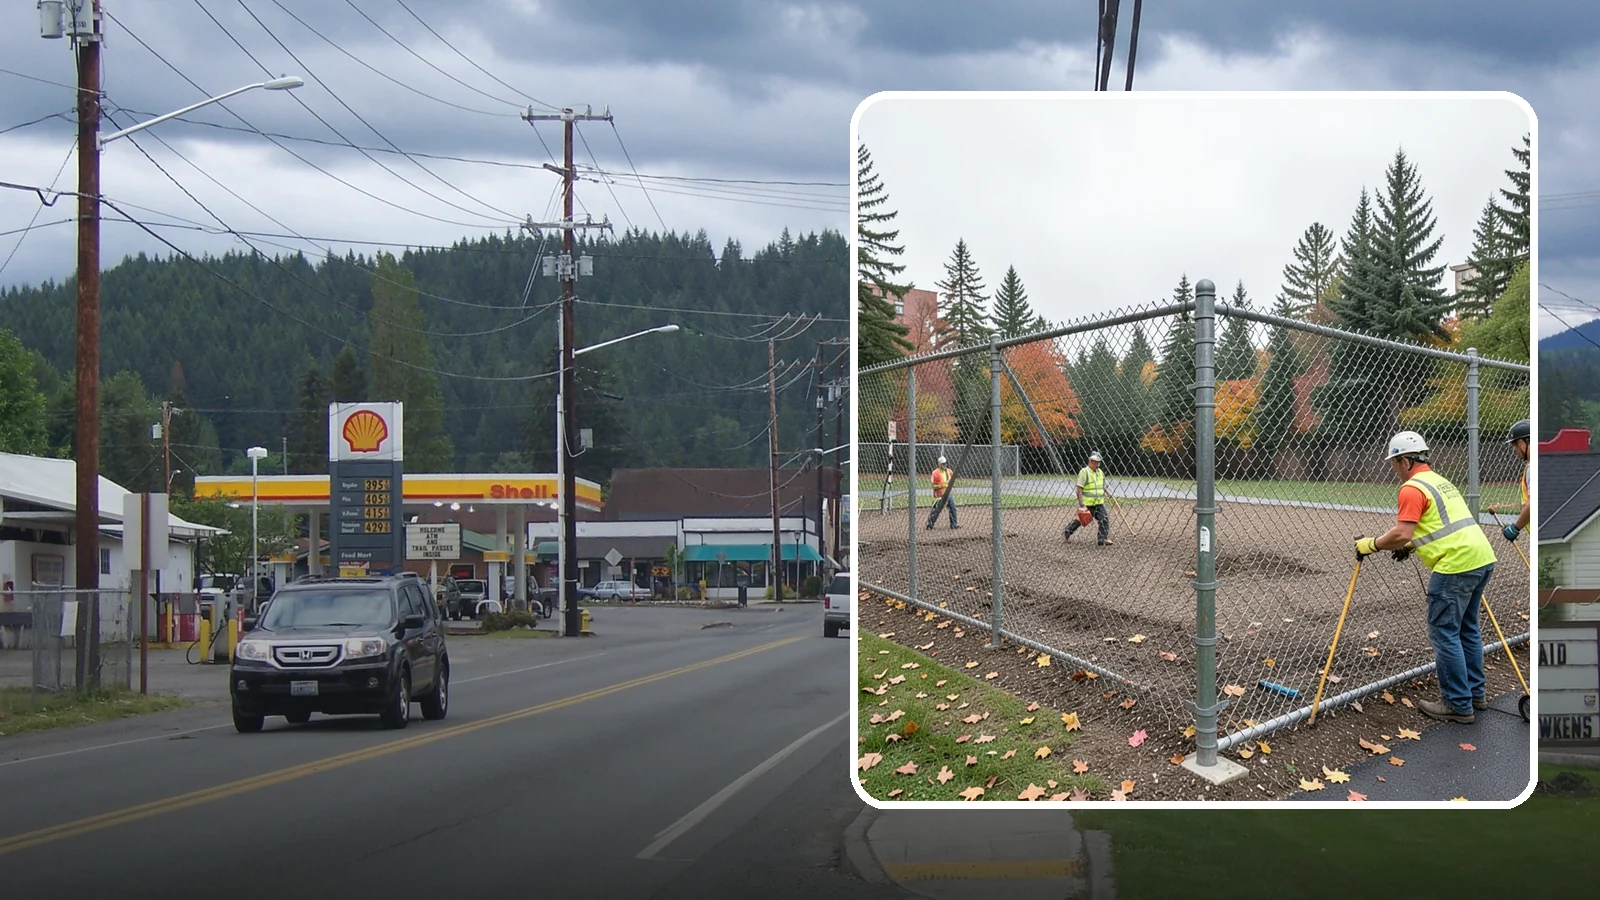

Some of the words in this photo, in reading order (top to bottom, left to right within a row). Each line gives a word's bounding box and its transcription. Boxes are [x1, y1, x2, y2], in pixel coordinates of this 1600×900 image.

[365, 480, 383, 490] 395
[490, 484, 547, 499] Shell
[365, 494, 383, 504] 405
[365, 508, 383, 518] 415
[366, 522, 383, 532] 429
